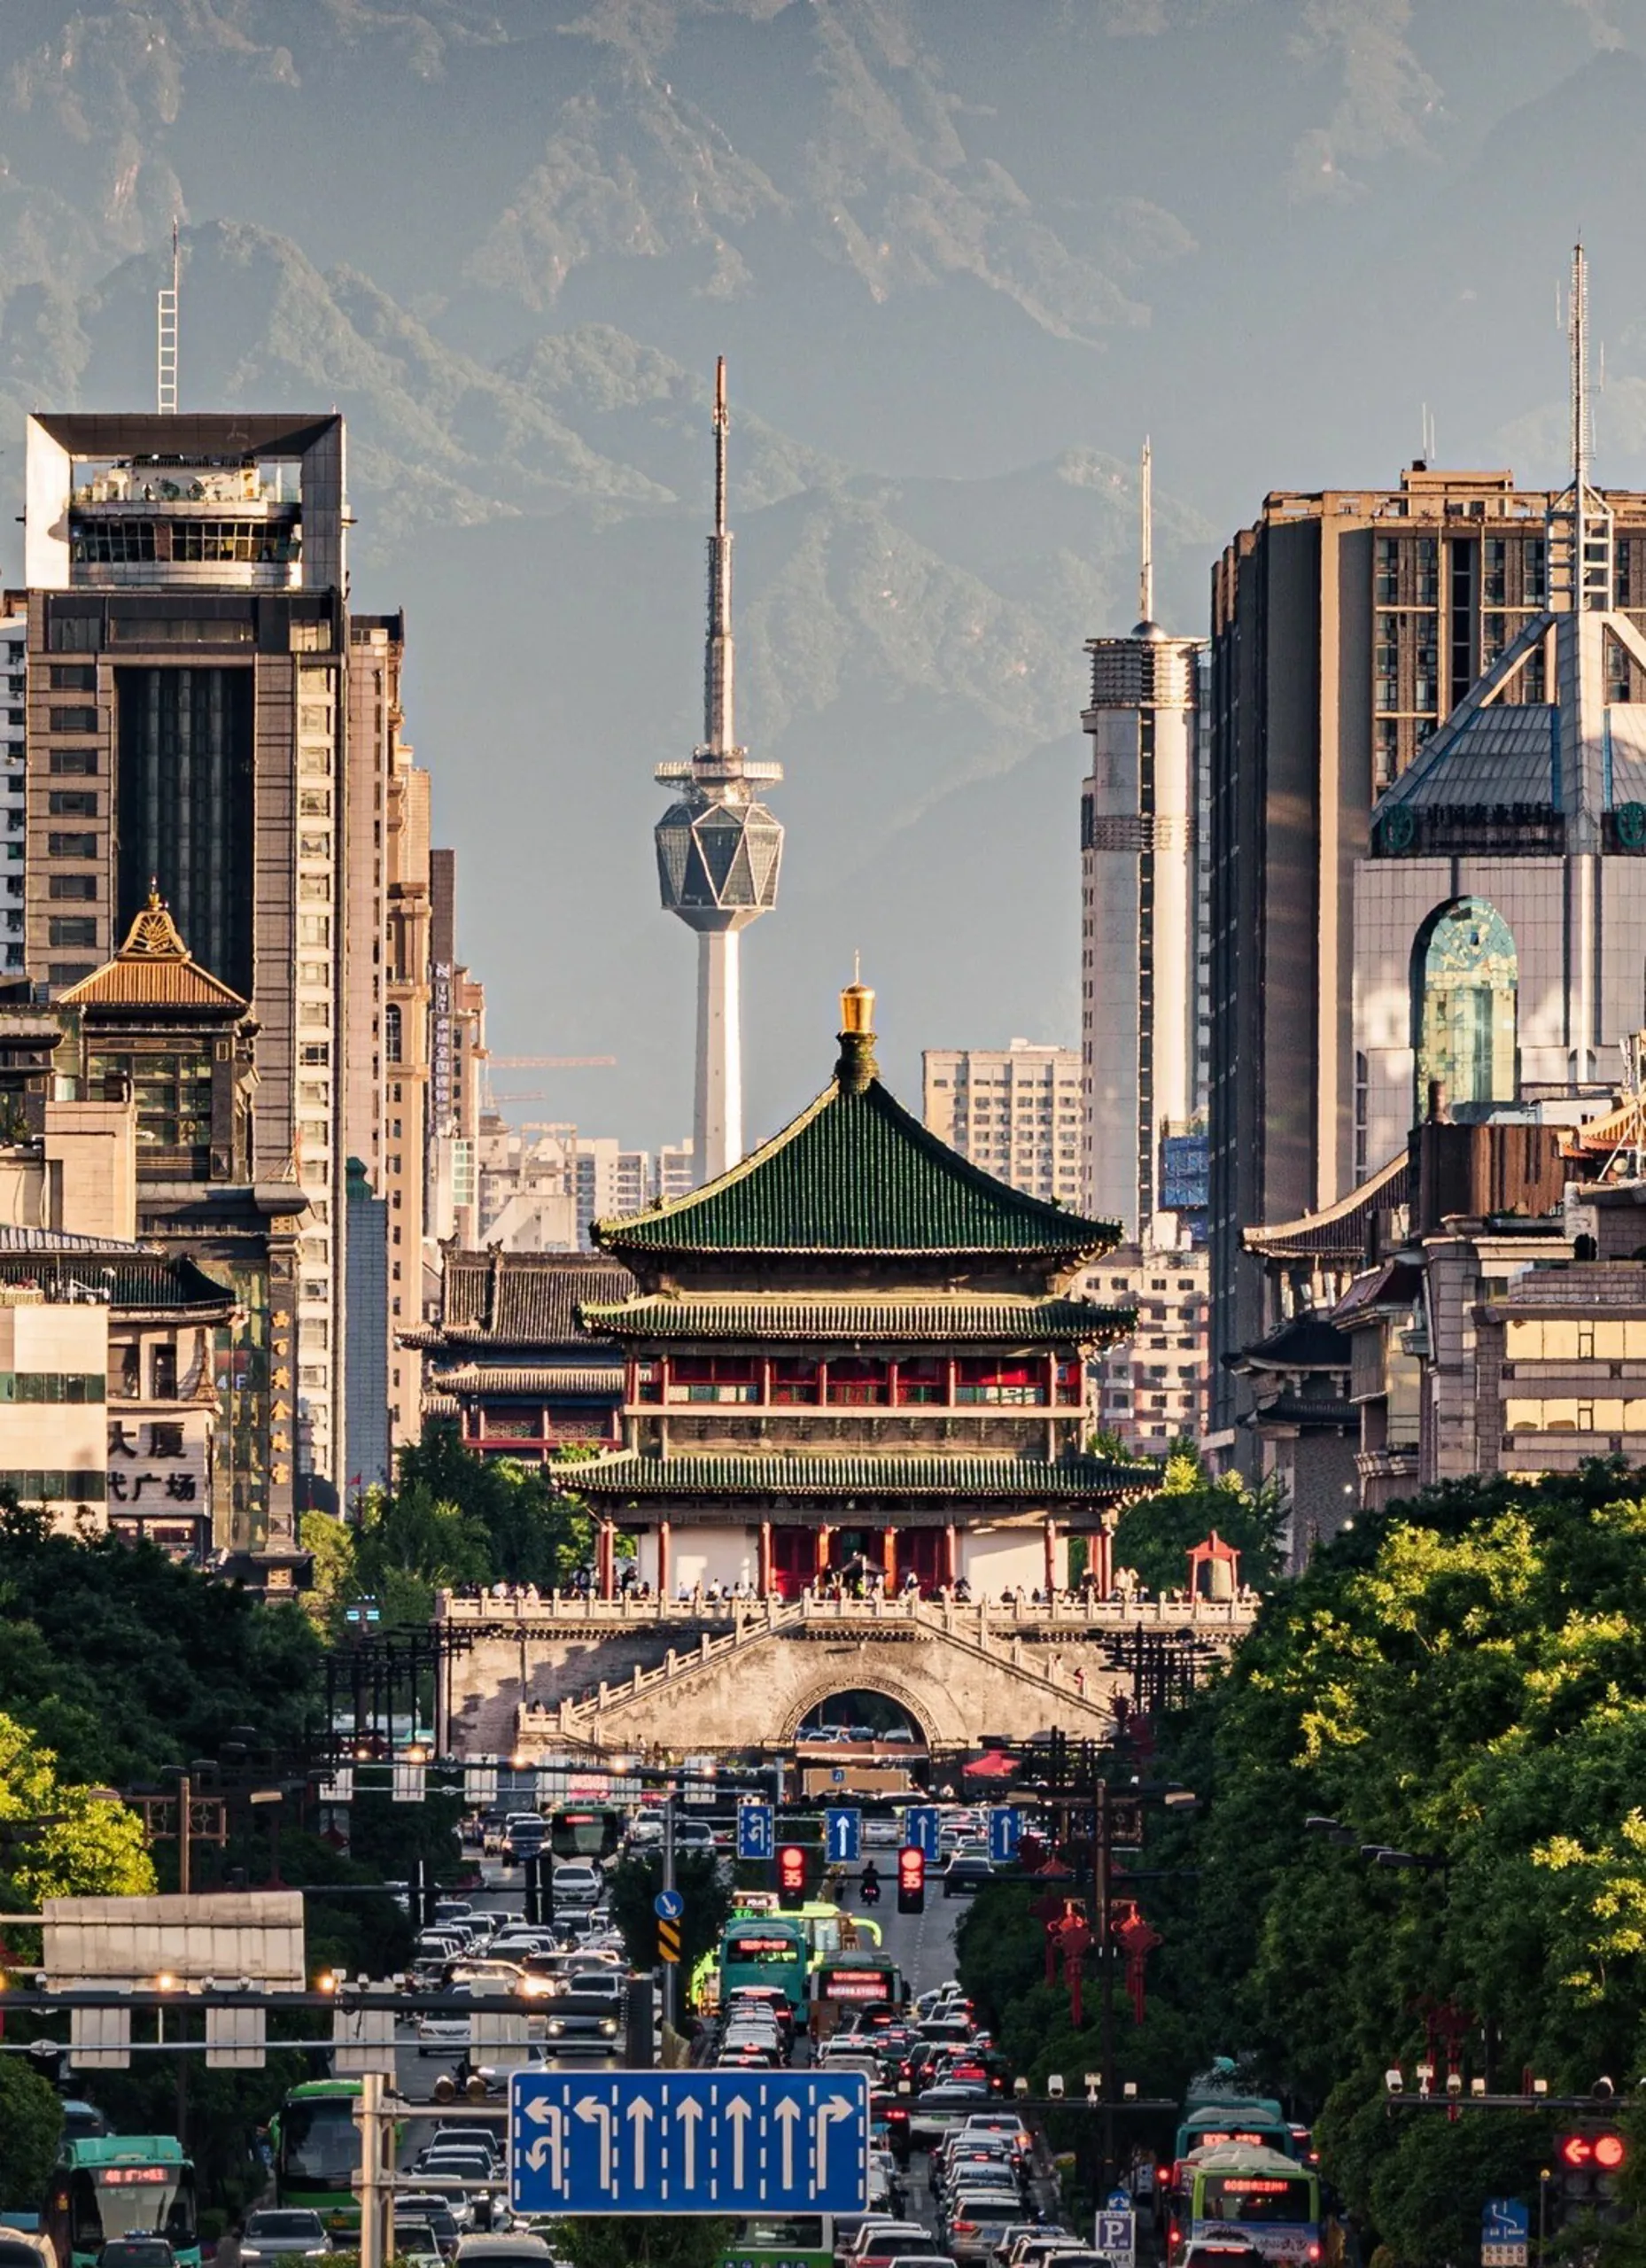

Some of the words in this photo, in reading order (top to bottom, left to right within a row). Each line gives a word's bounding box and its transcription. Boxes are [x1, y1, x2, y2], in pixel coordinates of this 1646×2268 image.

[217, 1375, 246, 1390] 4F
[108, 1420, 187, 1458] 大厦
[1103, 2220, 1124, 2248] P
